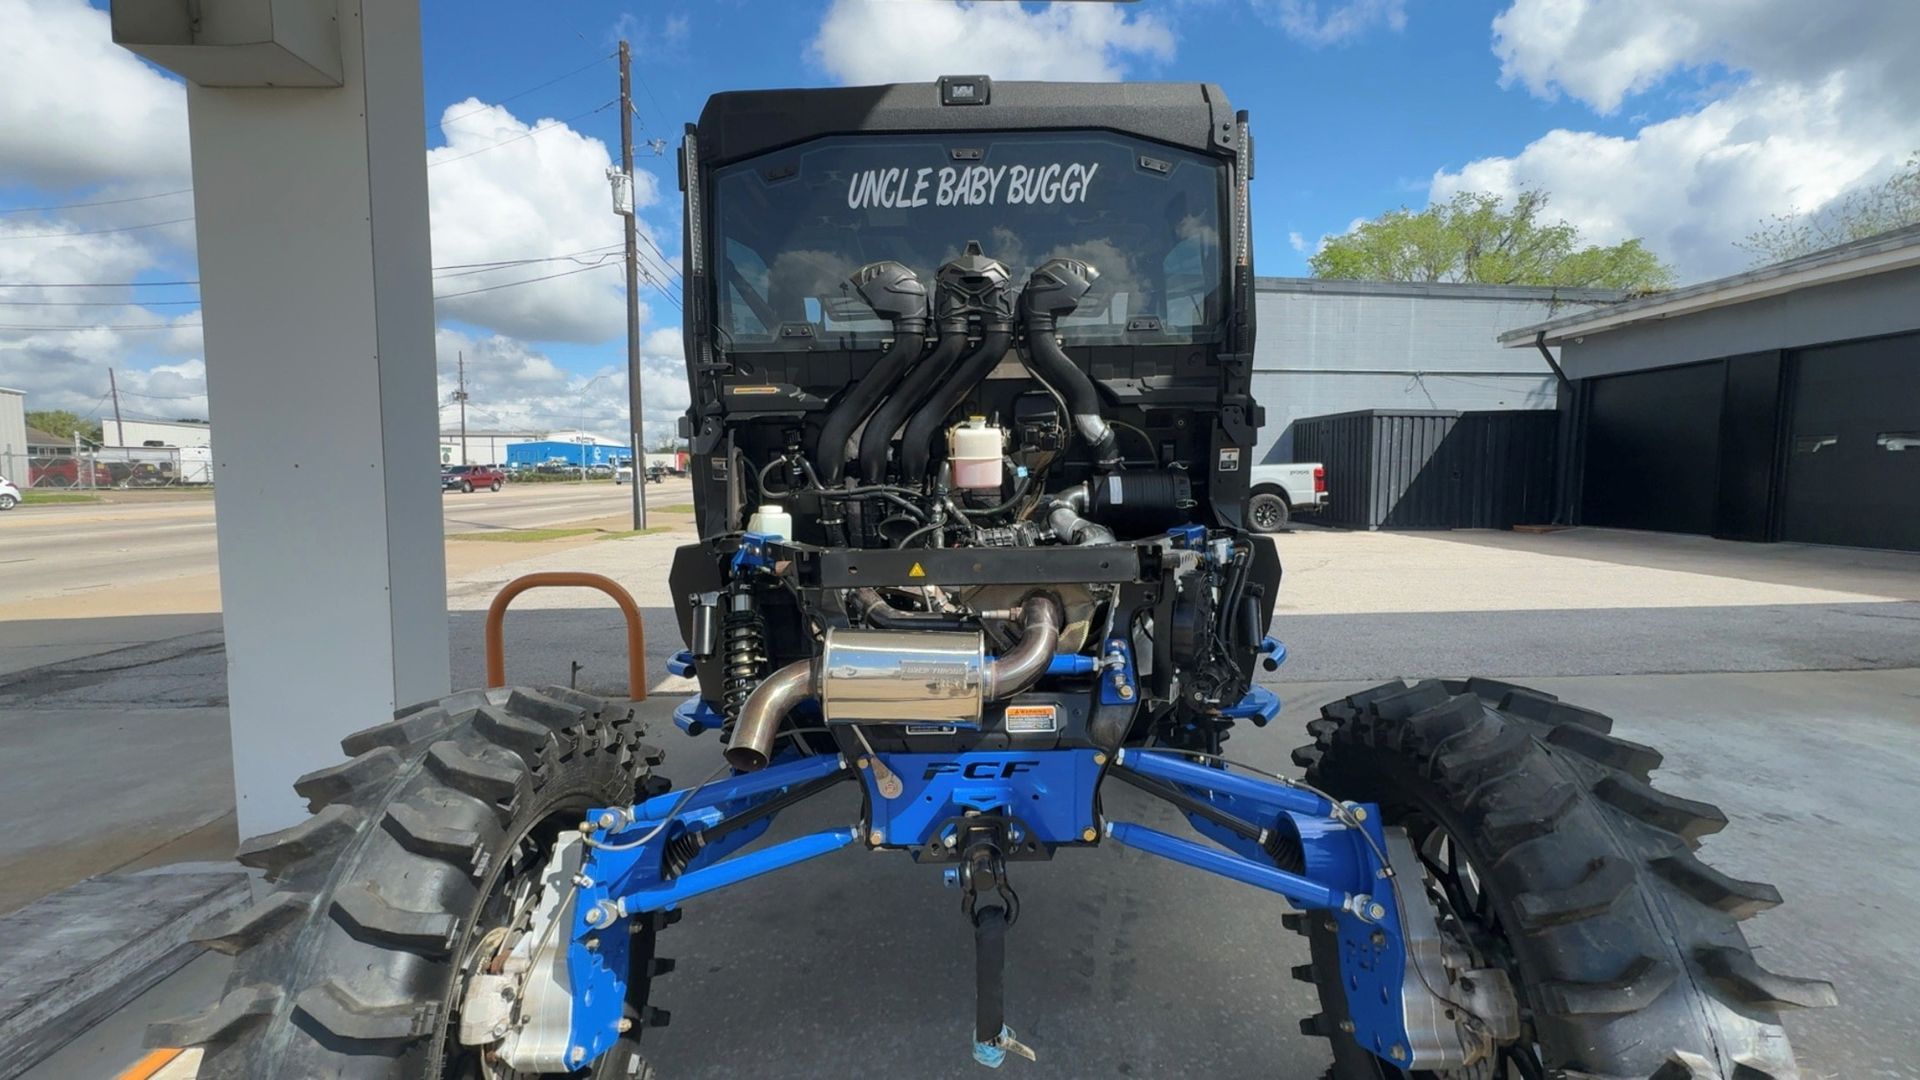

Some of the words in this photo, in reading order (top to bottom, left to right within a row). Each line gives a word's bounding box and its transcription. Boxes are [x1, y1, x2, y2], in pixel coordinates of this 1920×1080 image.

[848, 167, 933, 209] UNCLE
[936, 165, 1007, 207] BABY
[1007, 163, 1099, 205] BUGGY
[922, 761, 1040, 780] PCF
